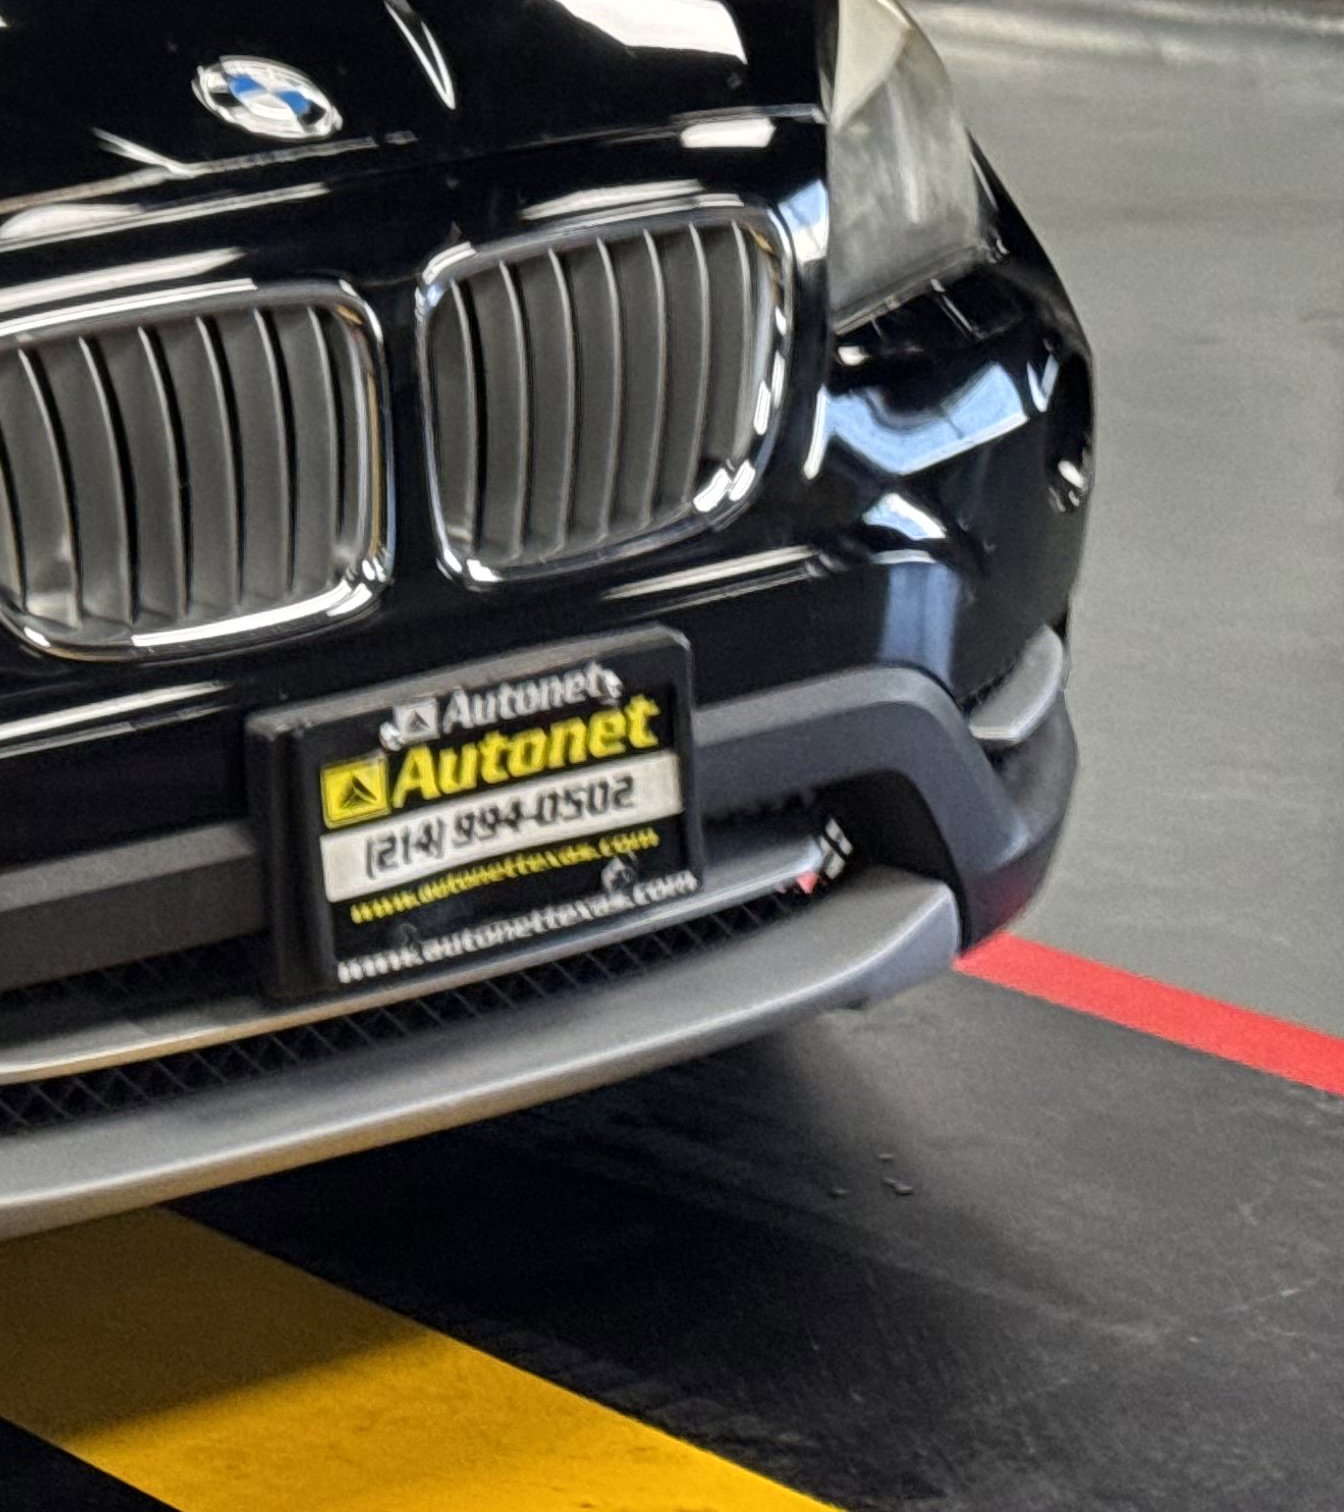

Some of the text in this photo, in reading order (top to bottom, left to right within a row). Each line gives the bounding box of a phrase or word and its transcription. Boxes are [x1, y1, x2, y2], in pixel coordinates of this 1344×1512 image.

[392, 694, 660, 808] Autonet
[443, 661, 614, 734] Autonet
[365, 770, 635, 881] (214) 994-0502
